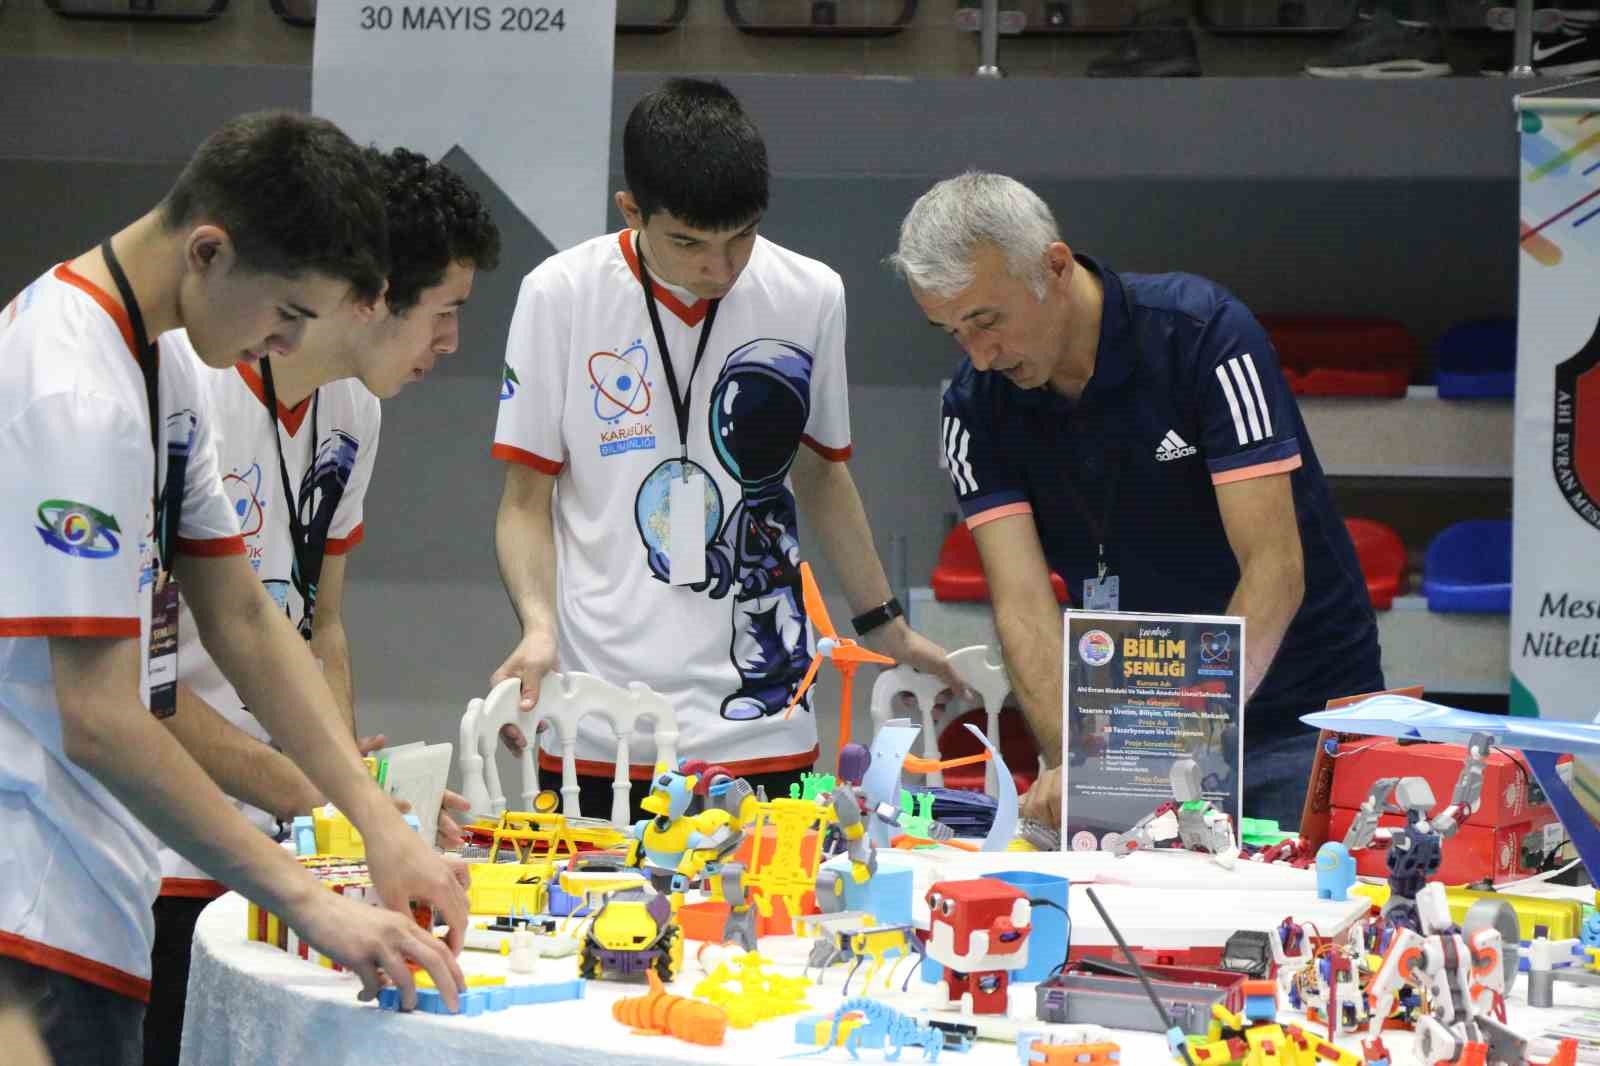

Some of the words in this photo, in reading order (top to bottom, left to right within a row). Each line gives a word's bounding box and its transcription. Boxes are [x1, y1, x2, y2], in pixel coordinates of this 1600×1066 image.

[361, 6, 393, 30] 30
[402, 6, 491, 31] MAYIS
[500, 7, 565, 32] 2024
[1155, 446, 1198, 461] adidas
[1556, 433, 1576, 490] EVRAN
[1123, 638, 1185, 658] BİLİM
[1123, 660, 1185, 679] ŞENLİĞİ
